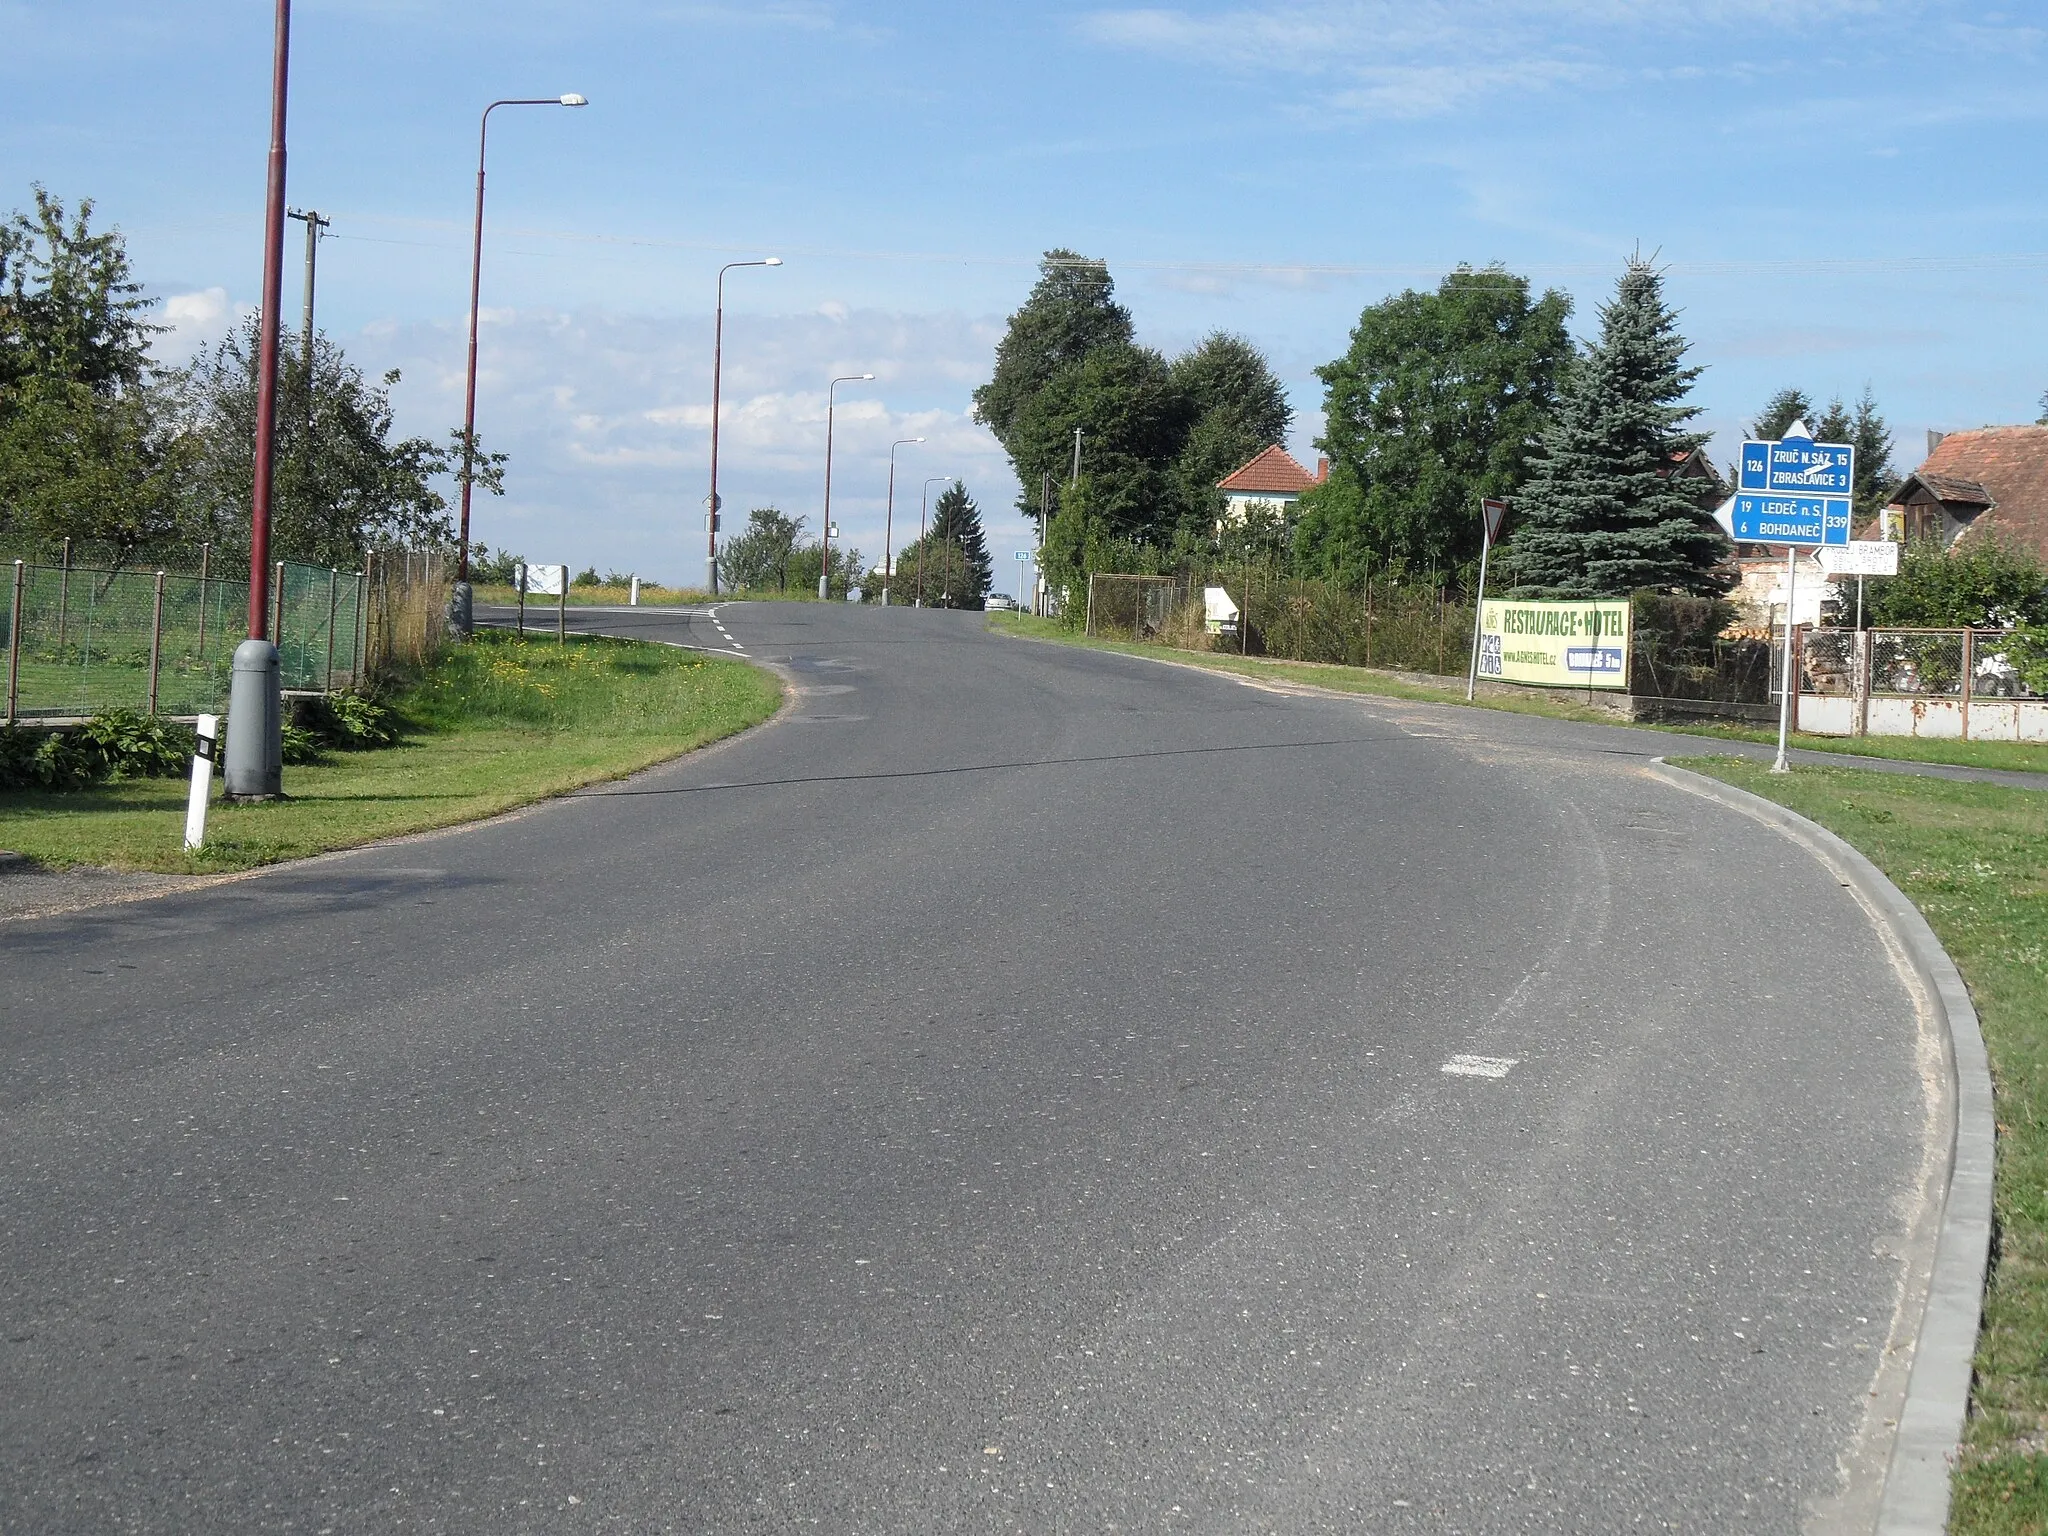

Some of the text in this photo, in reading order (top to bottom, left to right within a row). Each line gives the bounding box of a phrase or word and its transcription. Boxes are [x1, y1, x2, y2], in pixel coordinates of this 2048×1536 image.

[1773, 449, 1798, 463] ZRUČ
[1837, 454, 1848, 466] 15
[1747, 460, 1763, 472] 126
[1773, 472, 1846, 486] ZBRASLAVICE 3
[1740, 501, 1752, 512] 19
[1761, 501, 1797, 515] LEDEČ
[1826, 516, 1847, 528] 339
[1740, 522, 1820, 537] 6 BOHDANEČ
